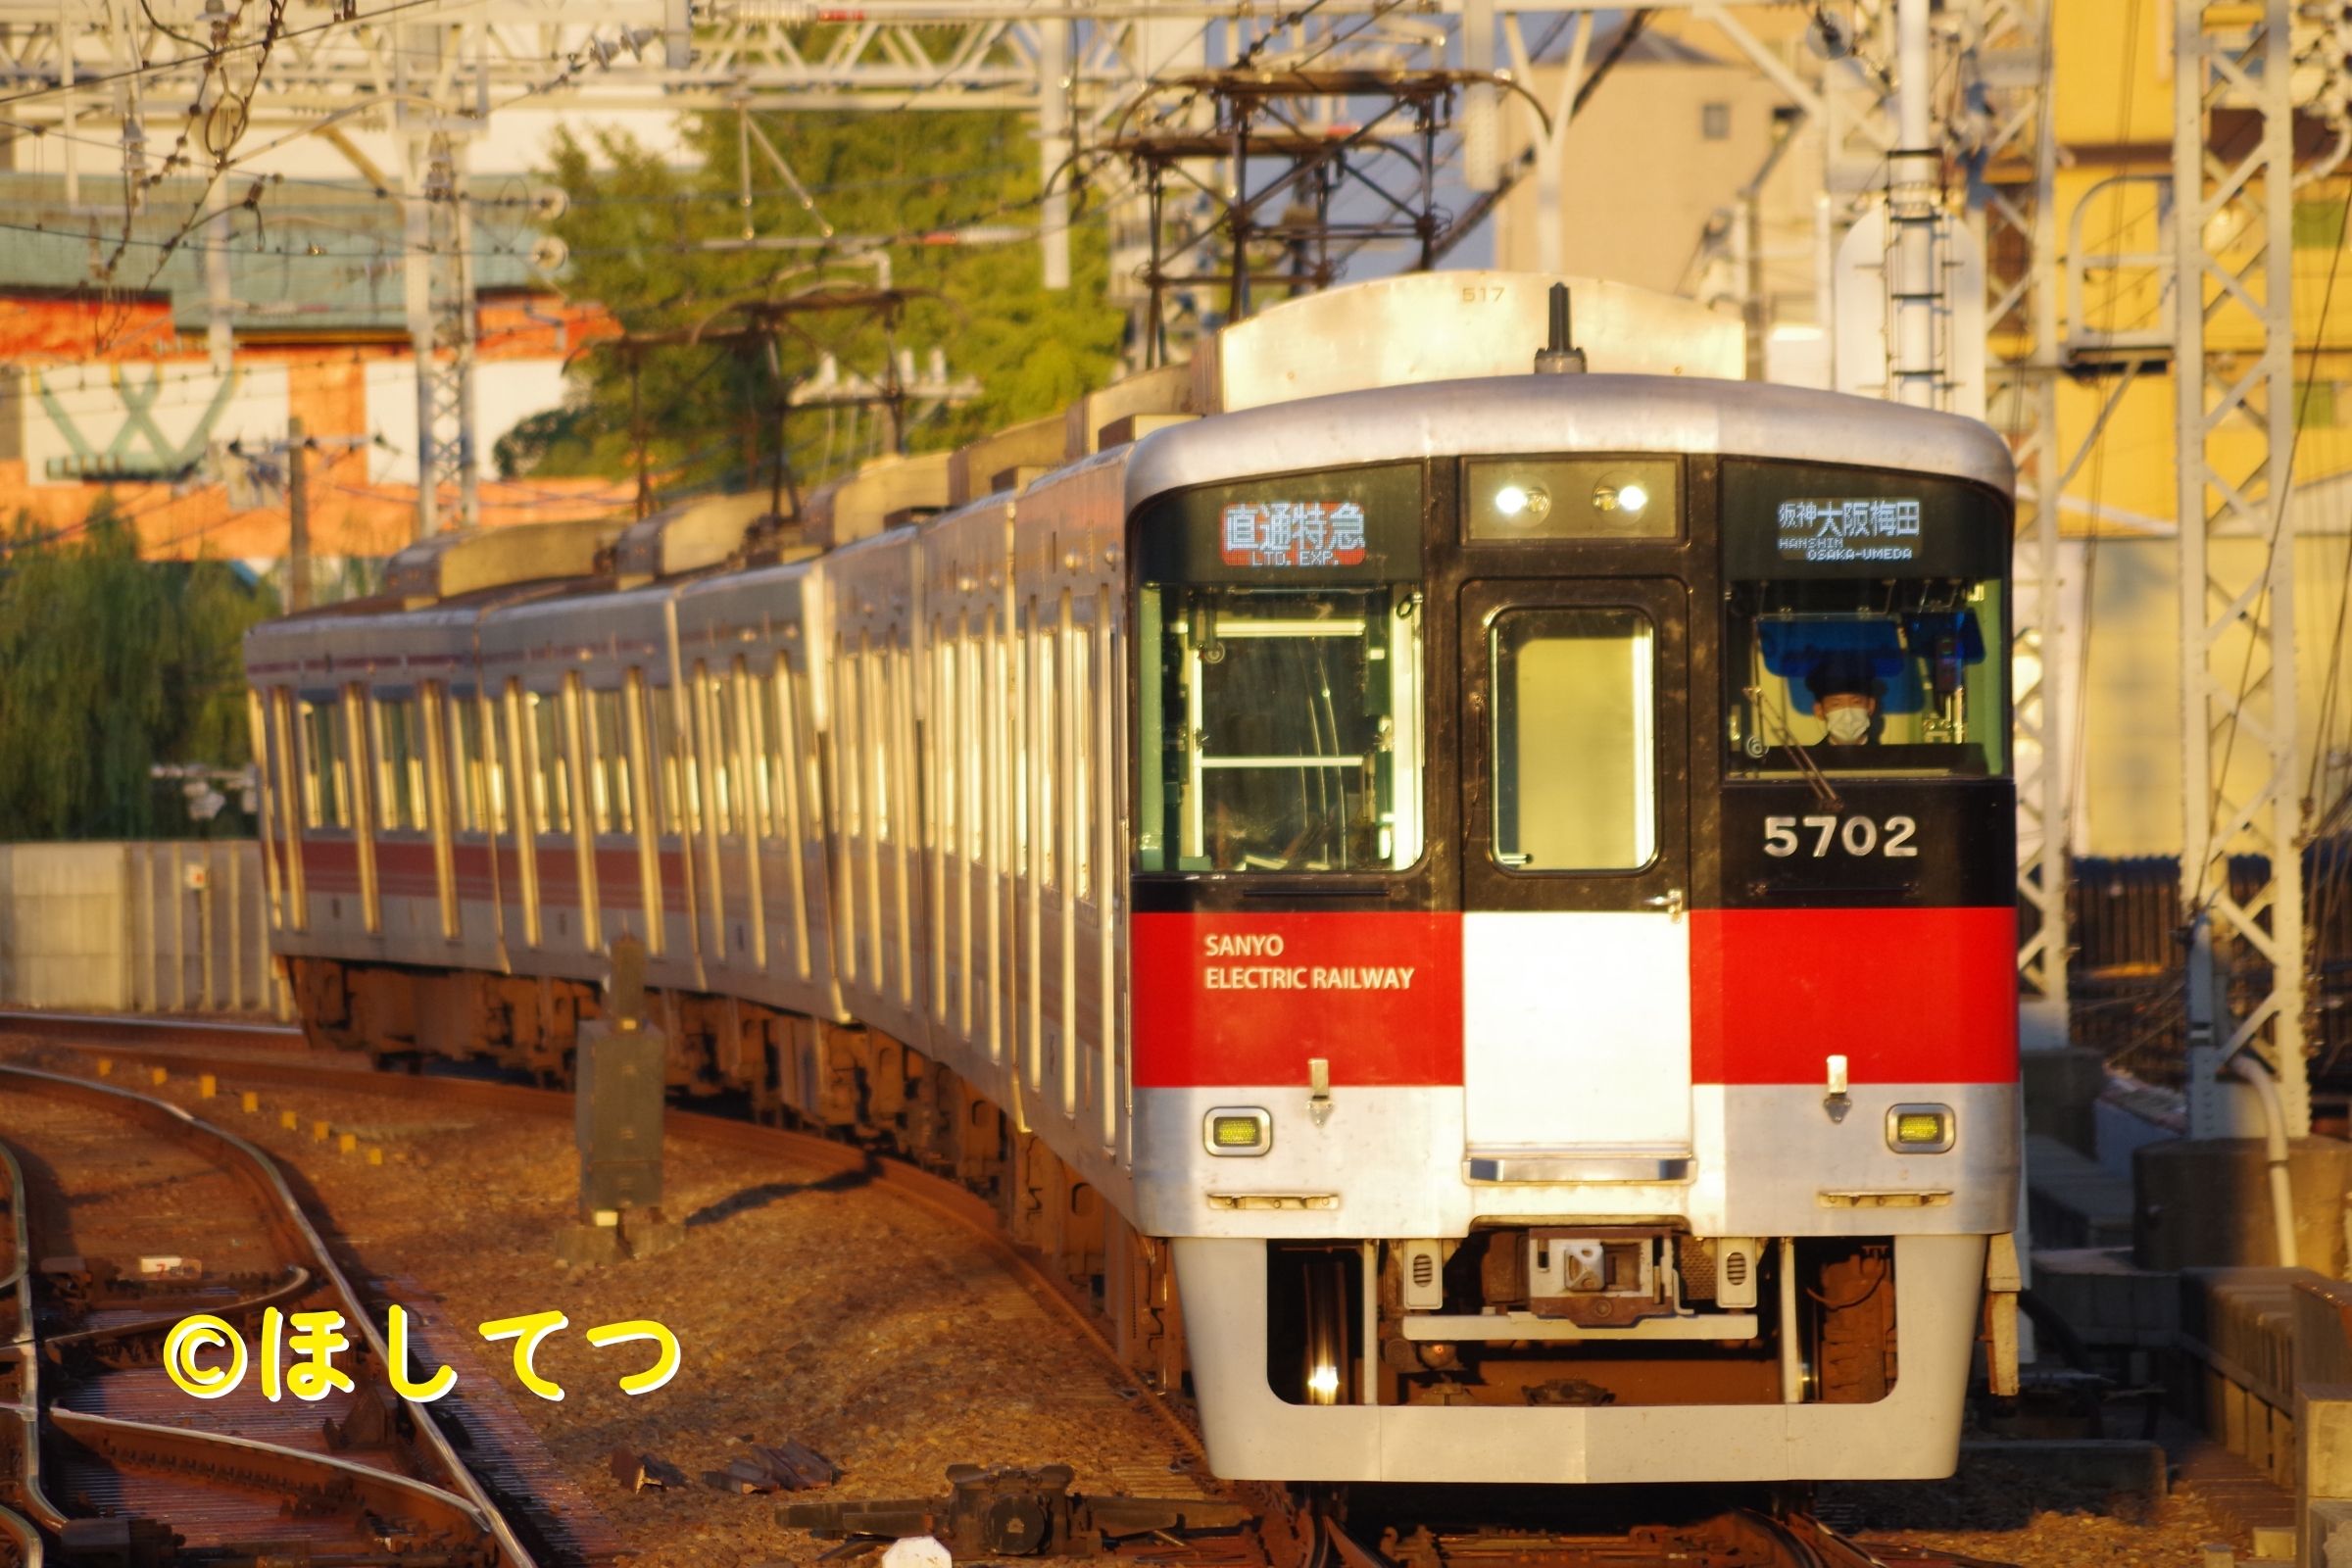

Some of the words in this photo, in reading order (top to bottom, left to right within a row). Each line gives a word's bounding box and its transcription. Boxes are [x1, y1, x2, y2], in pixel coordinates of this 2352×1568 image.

[1226, 502, 1365, 550] 直通特急
[1779, 537, 1843, 550] HANSHIN
[1806, 548, 1912, 561] OSAKA-UMEDA
[1251, 551, 1291, 565] LTD.
[1299, 551, 1340, 565] EXP.
[1764, 815, 1918, 858] 5702
[1204, 934, 1285, 956] SANYO
[1205, 966, 1308, 990] ELECTRIC
[1312, 966, 1415, 990] RAILWAY
